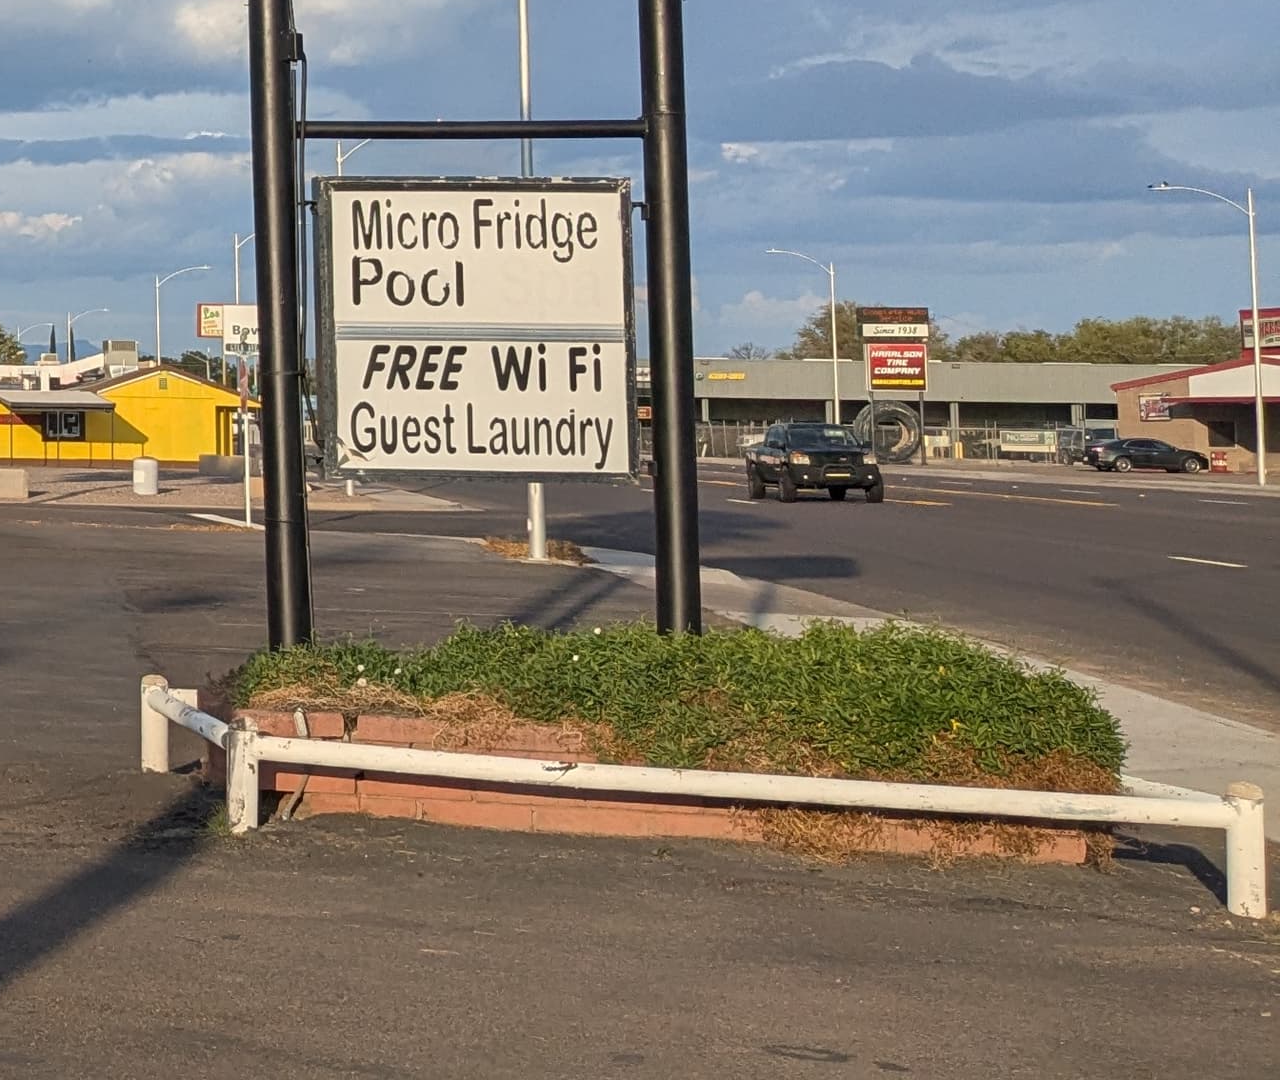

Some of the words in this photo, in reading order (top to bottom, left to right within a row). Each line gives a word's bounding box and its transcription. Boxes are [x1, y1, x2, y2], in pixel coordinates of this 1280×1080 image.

[352, 199, 460, 250] Micro
[473, 198, 598, 263] Fridge
[352, 255, 465, 307] Pool
[873, 325, 895, 335] Since
[897, 326, 918, 335] 1938
[362, 344, 468, 391] FREE
[874, 367, 921, 375] COMPANY
[350, 401, 457, 454] Guest
[466, 402, 613, 470] Laundry
